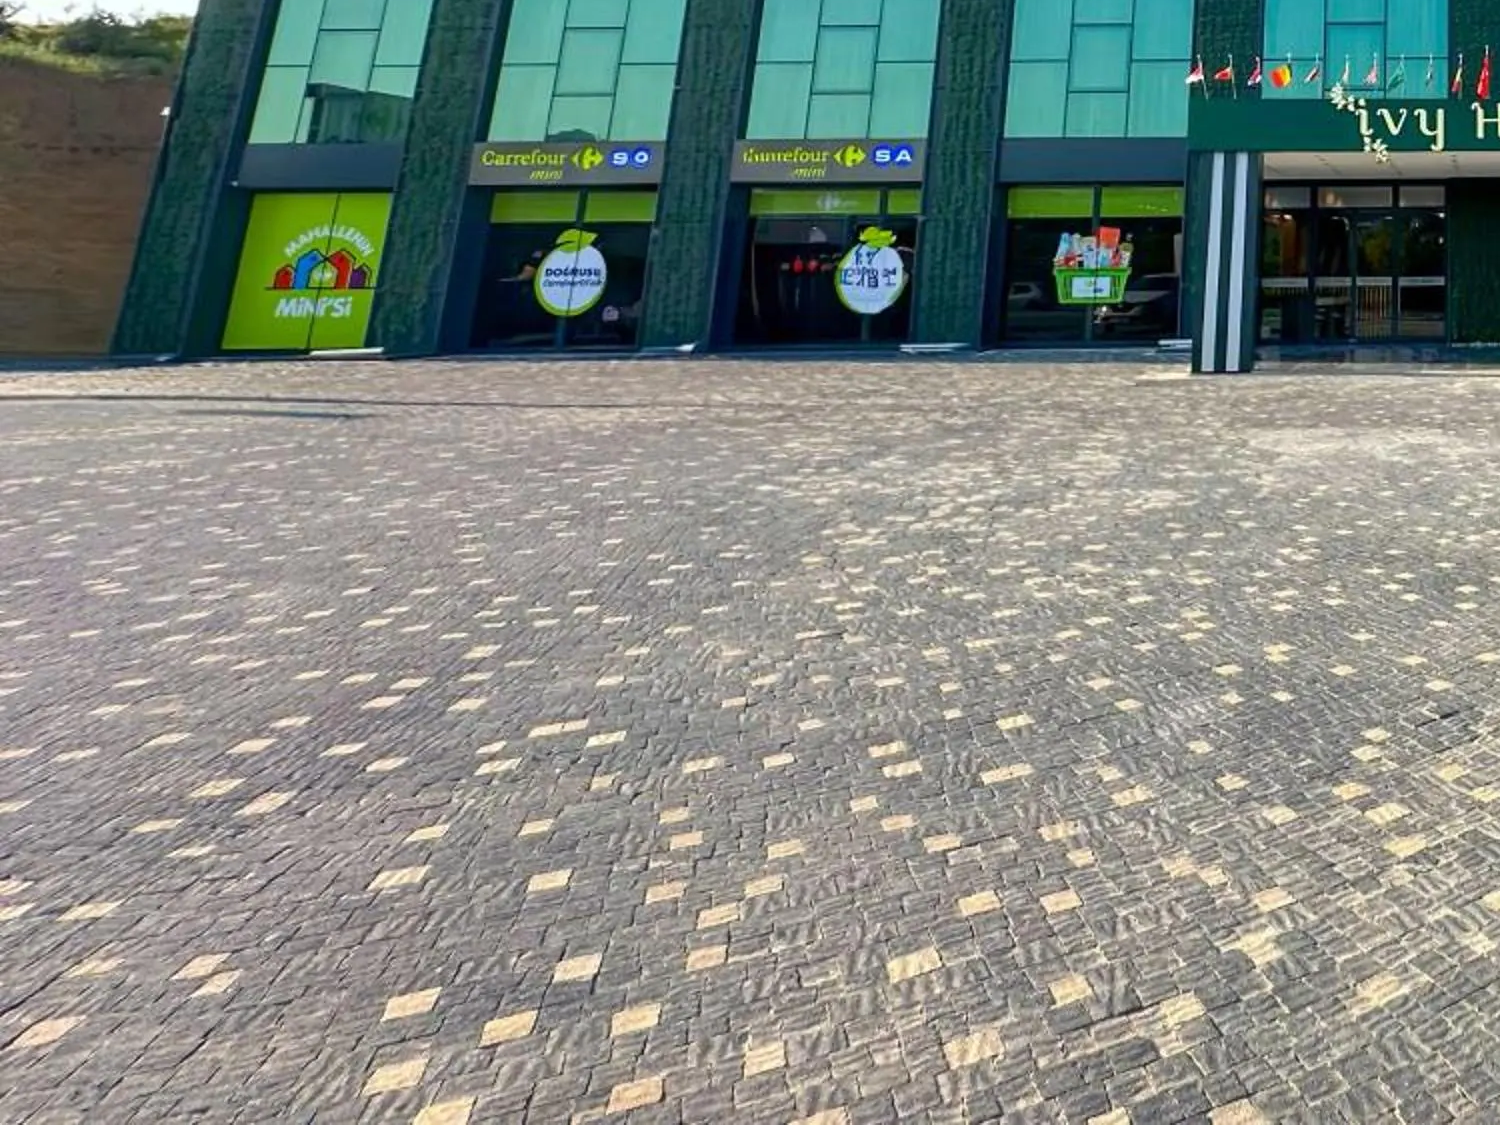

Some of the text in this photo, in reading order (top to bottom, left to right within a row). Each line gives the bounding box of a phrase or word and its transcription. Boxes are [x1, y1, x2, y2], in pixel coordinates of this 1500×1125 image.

[1354, 97, 1445, 152] ivy
[481, 148, 566, 167] Carrefour
[874, 149, 912, 163] SA
